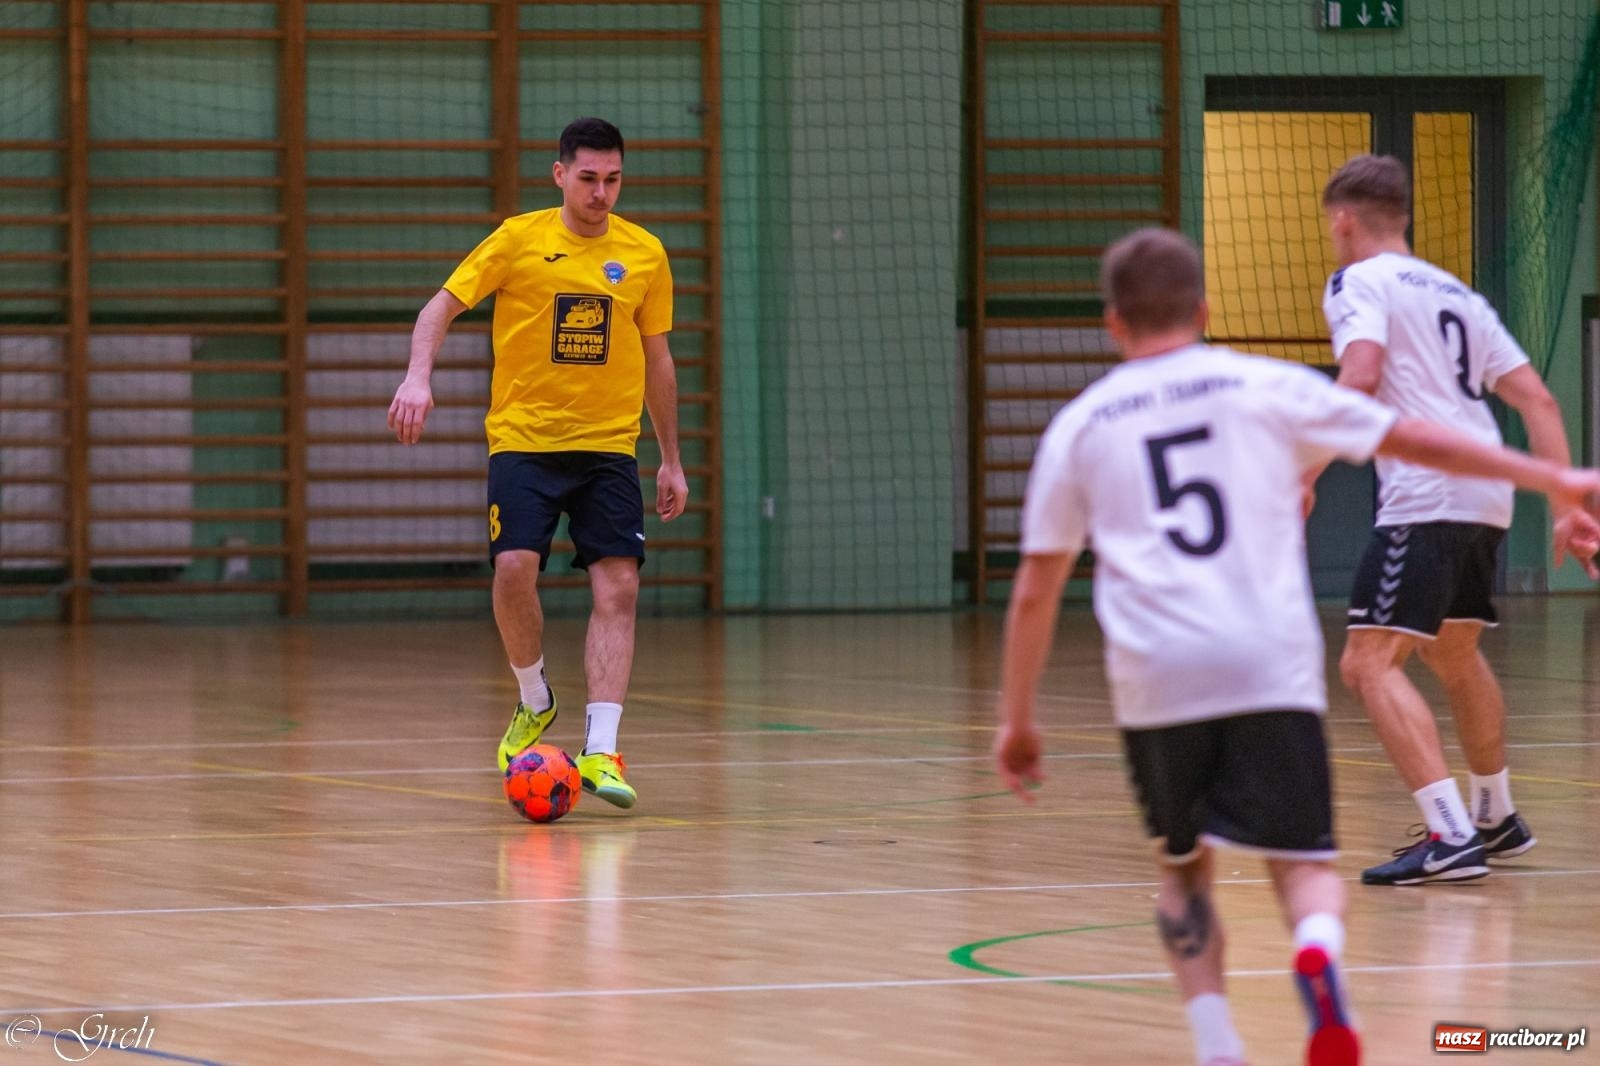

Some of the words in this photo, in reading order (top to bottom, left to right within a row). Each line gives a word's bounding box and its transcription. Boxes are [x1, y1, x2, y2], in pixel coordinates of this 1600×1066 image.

[557, 343, 604, 354] GARAGE
[558, 332, 604, 344] STOPIW
[1145, 425, 1226, 557] 5
[489, 503, 501, 542] 8
